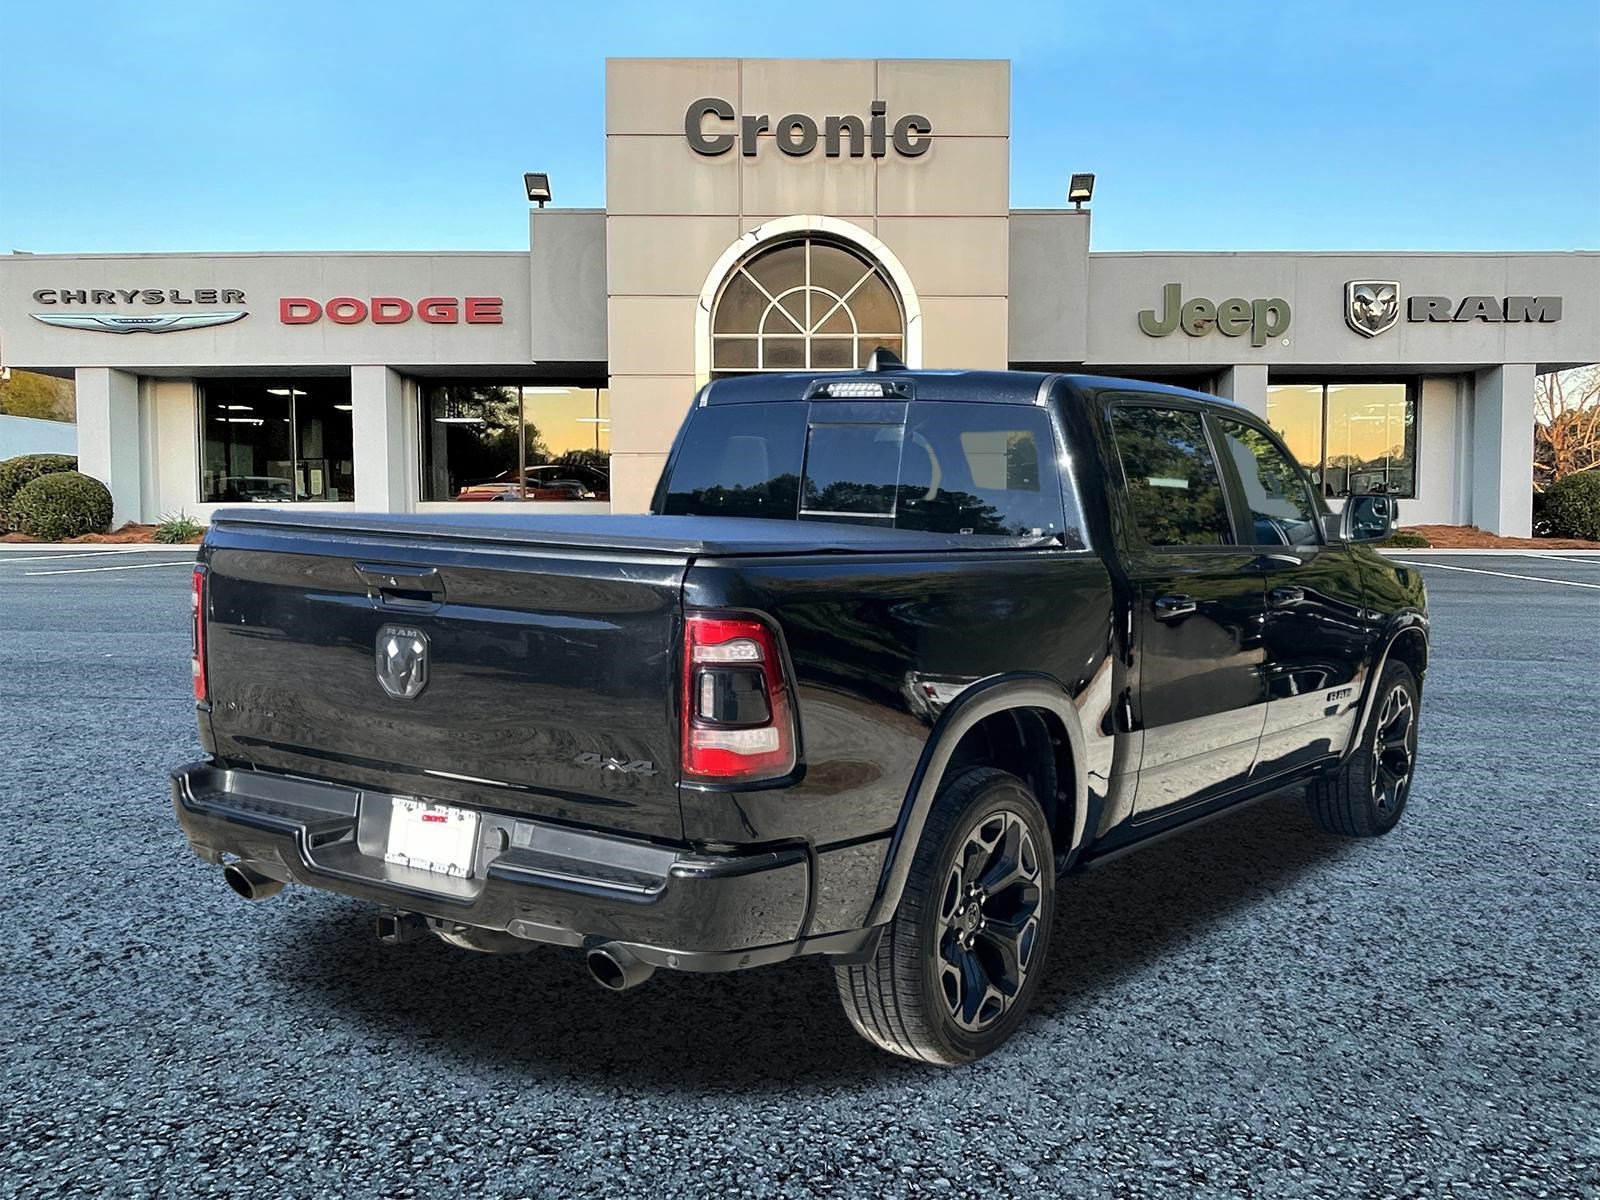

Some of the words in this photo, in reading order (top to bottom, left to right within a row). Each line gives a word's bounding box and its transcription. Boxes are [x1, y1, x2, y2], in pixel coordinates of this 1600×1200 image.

[685, 97, 932, 157] Cronic
[32, 289, 247, 304] CHRYSLER
[1407, 296, 1563, 322] RAM
[280, 297, 504, 324] DODGE
[1138, 283, 1291, 347] Jeep
[386, 628, 417, 637] RAM
